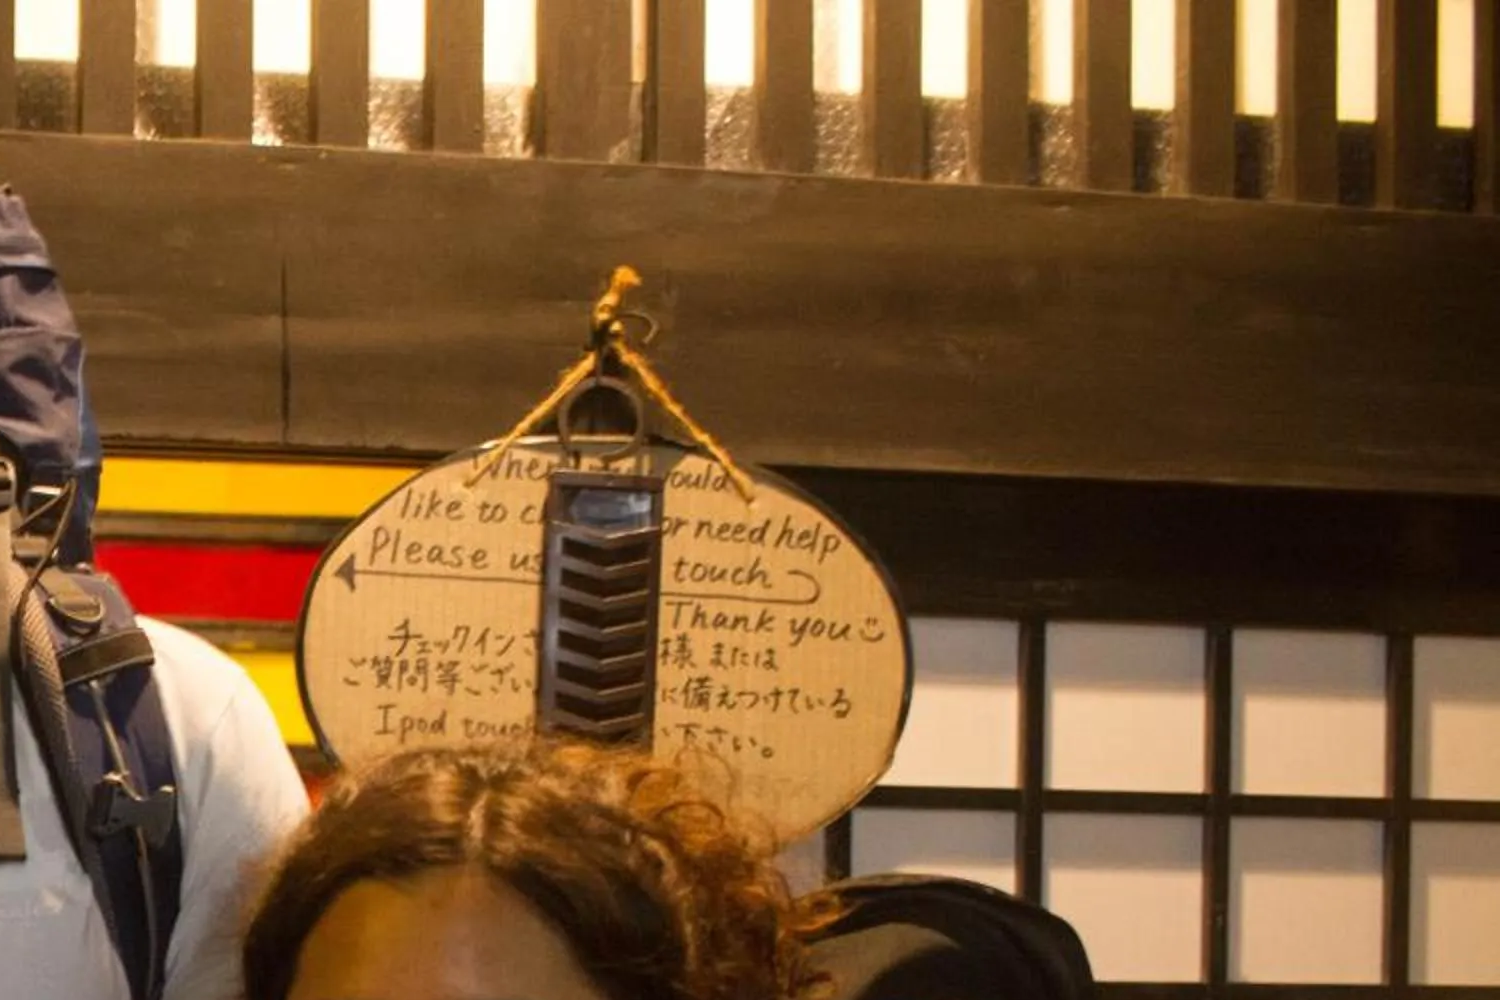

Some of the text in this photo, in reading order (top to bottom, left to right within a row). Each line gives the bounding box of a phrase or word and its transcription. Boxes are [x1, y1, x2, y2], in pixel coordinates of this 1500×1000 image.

[663, 463, 730, 492] ould
[401, 487, 464, 521] like
[477, 499, 508, 524] to
[694, 518, 771, 547] need
[774, 514, 841, 564] help
[368, 525, 489, 570] Please
[673, 555, 773, 588] touch
[665, 601, 851, 647] Thank you
